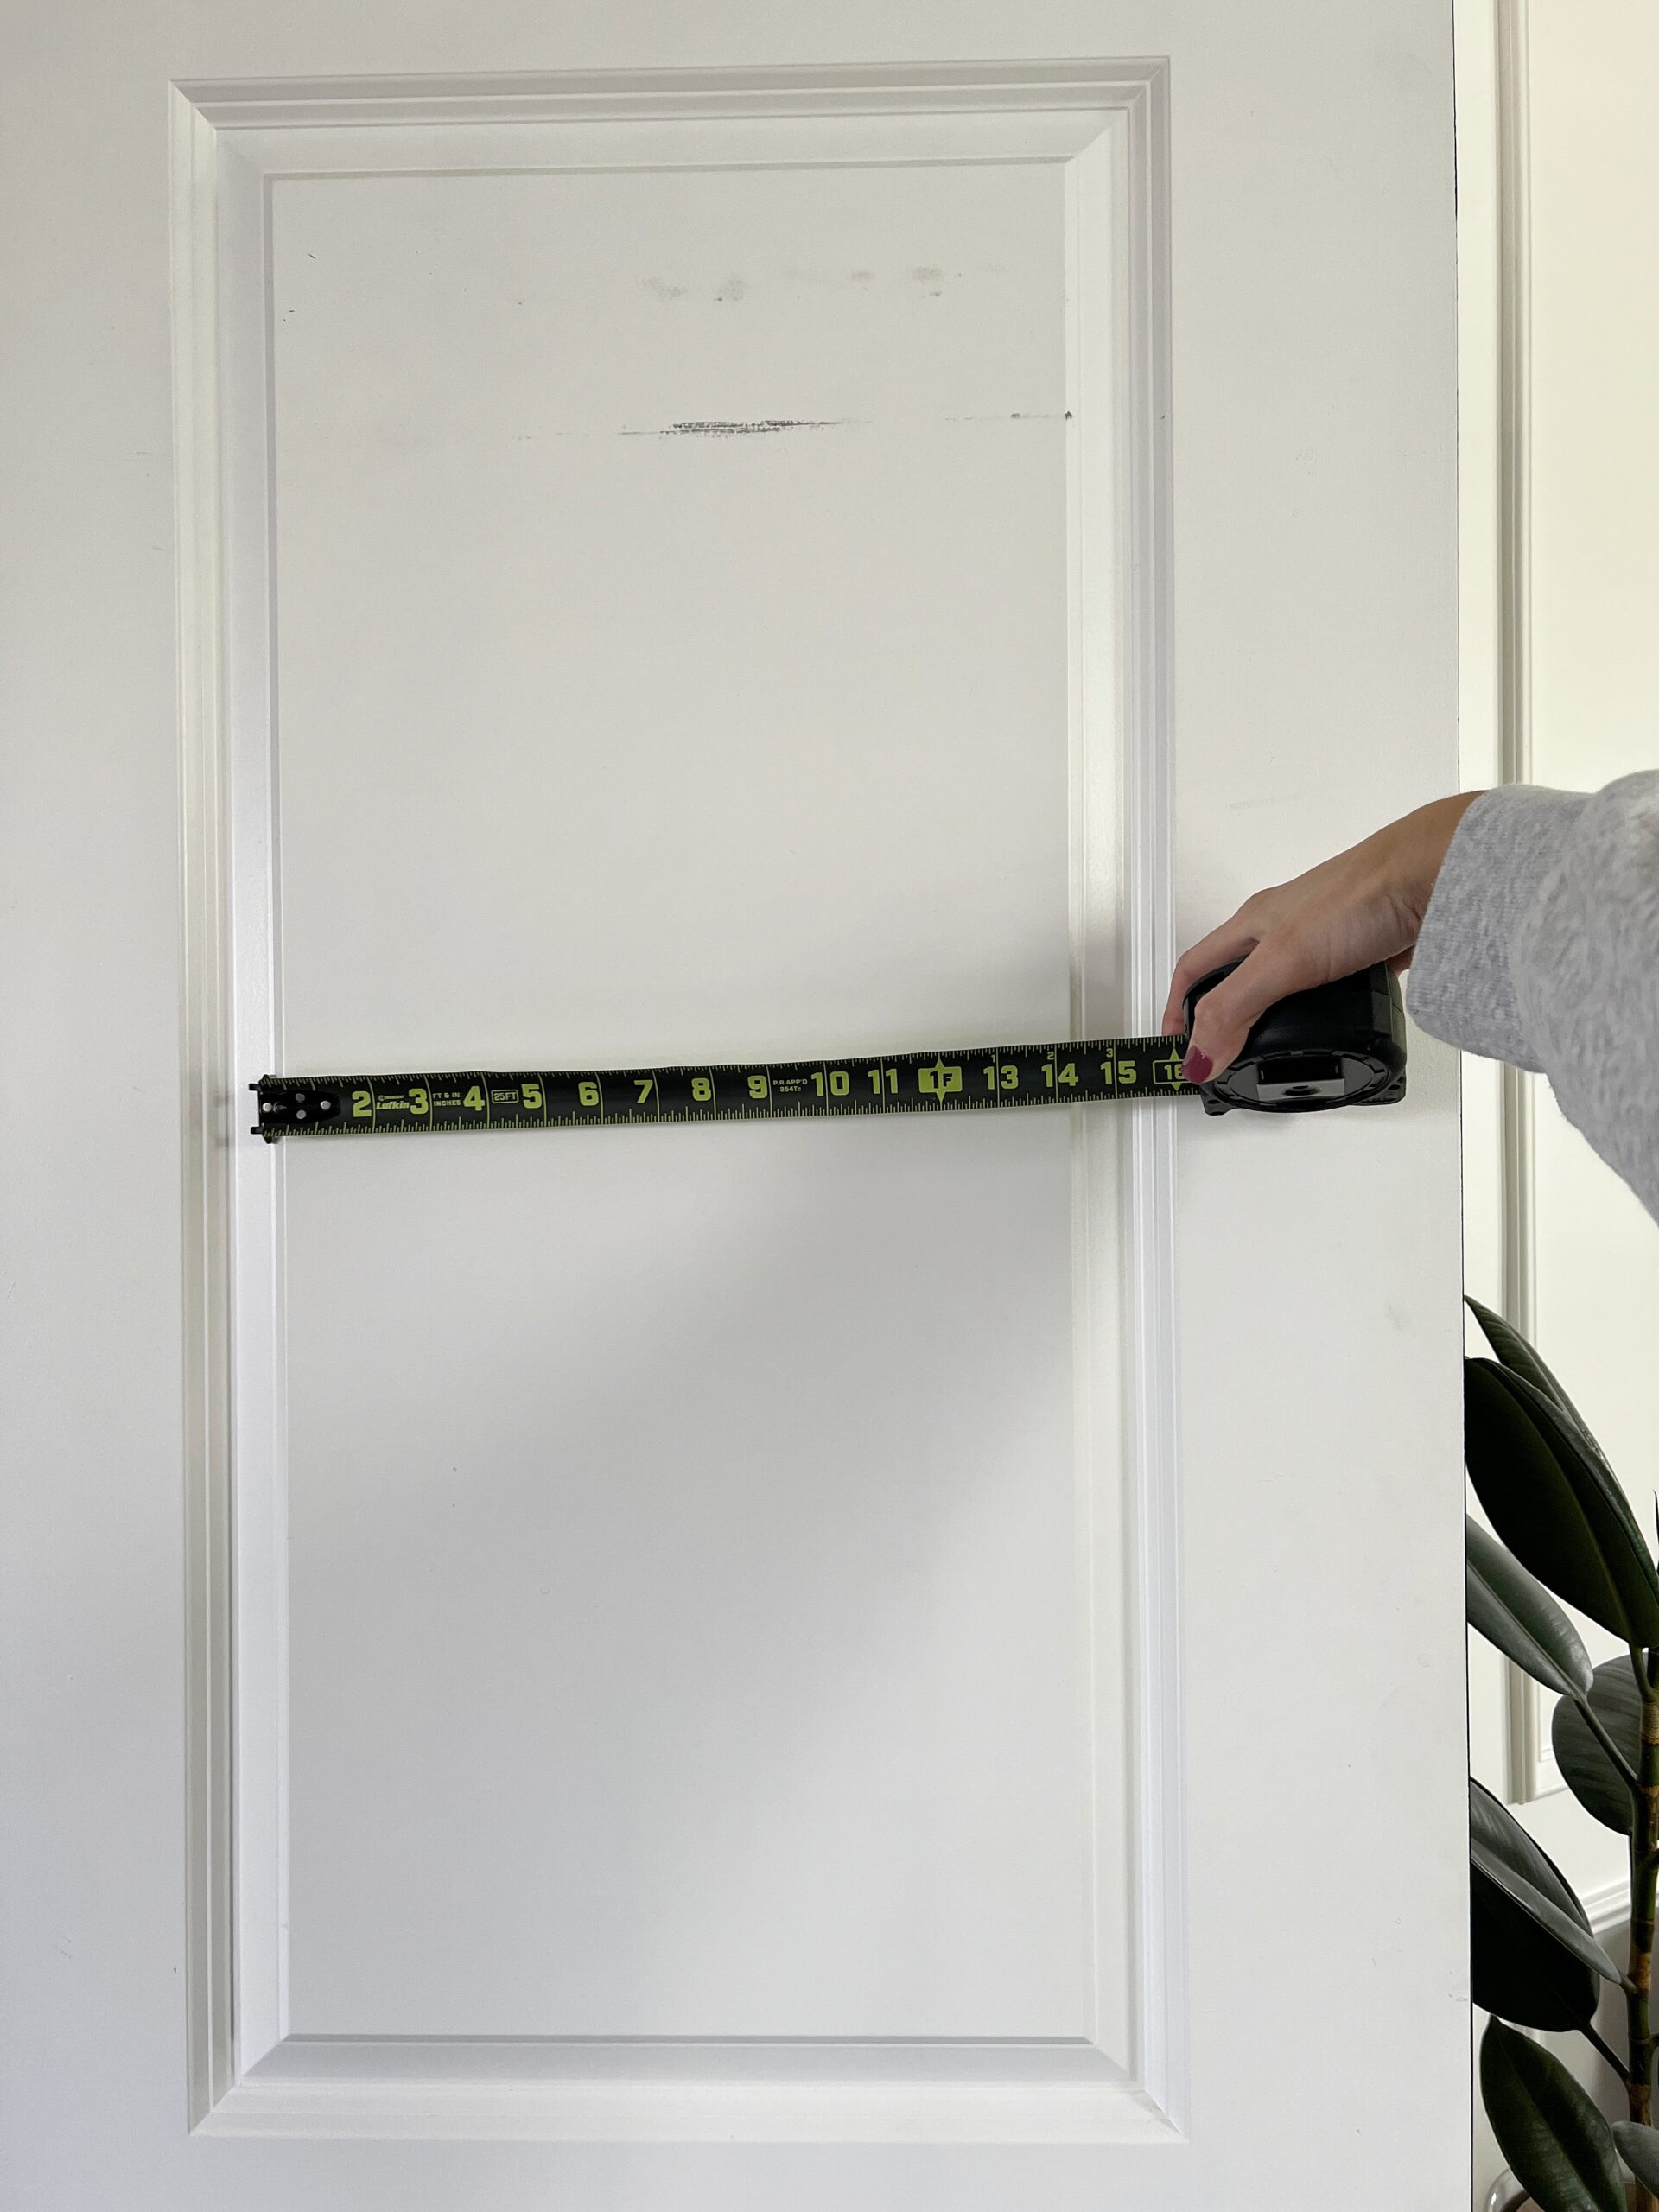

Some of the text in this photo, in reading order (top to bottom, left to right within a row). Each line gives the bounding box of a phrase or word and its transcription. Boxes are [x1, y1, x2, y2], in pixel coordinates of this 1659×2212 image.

[1046, 1051, 1055, 1061] 2
[1105, 1048, 1114, 1058] 3
[810, 1071, 850, 1097] 10
[868, 1068, 899, 1095] 11
[982, 1065, 1019, 1090] 13
[1041, 1062, 1079, 1088] 14
[1100, 1060, 1137, 1085] 15
[462, 1085, 486, 1111] 4
[493, 1091, 517, 1101] 25FT
[521, 1083, 543, 1109] 5
[578, 1081, 599, 1106] 6
[633, 1079, 653, 1104] 7
[691, 1077, 711, 1102] 8
[747, 1075, 768, 1099] 9
[352, 1090, 372, 1117] 2
[408, 1088, 429, 1115] 3
